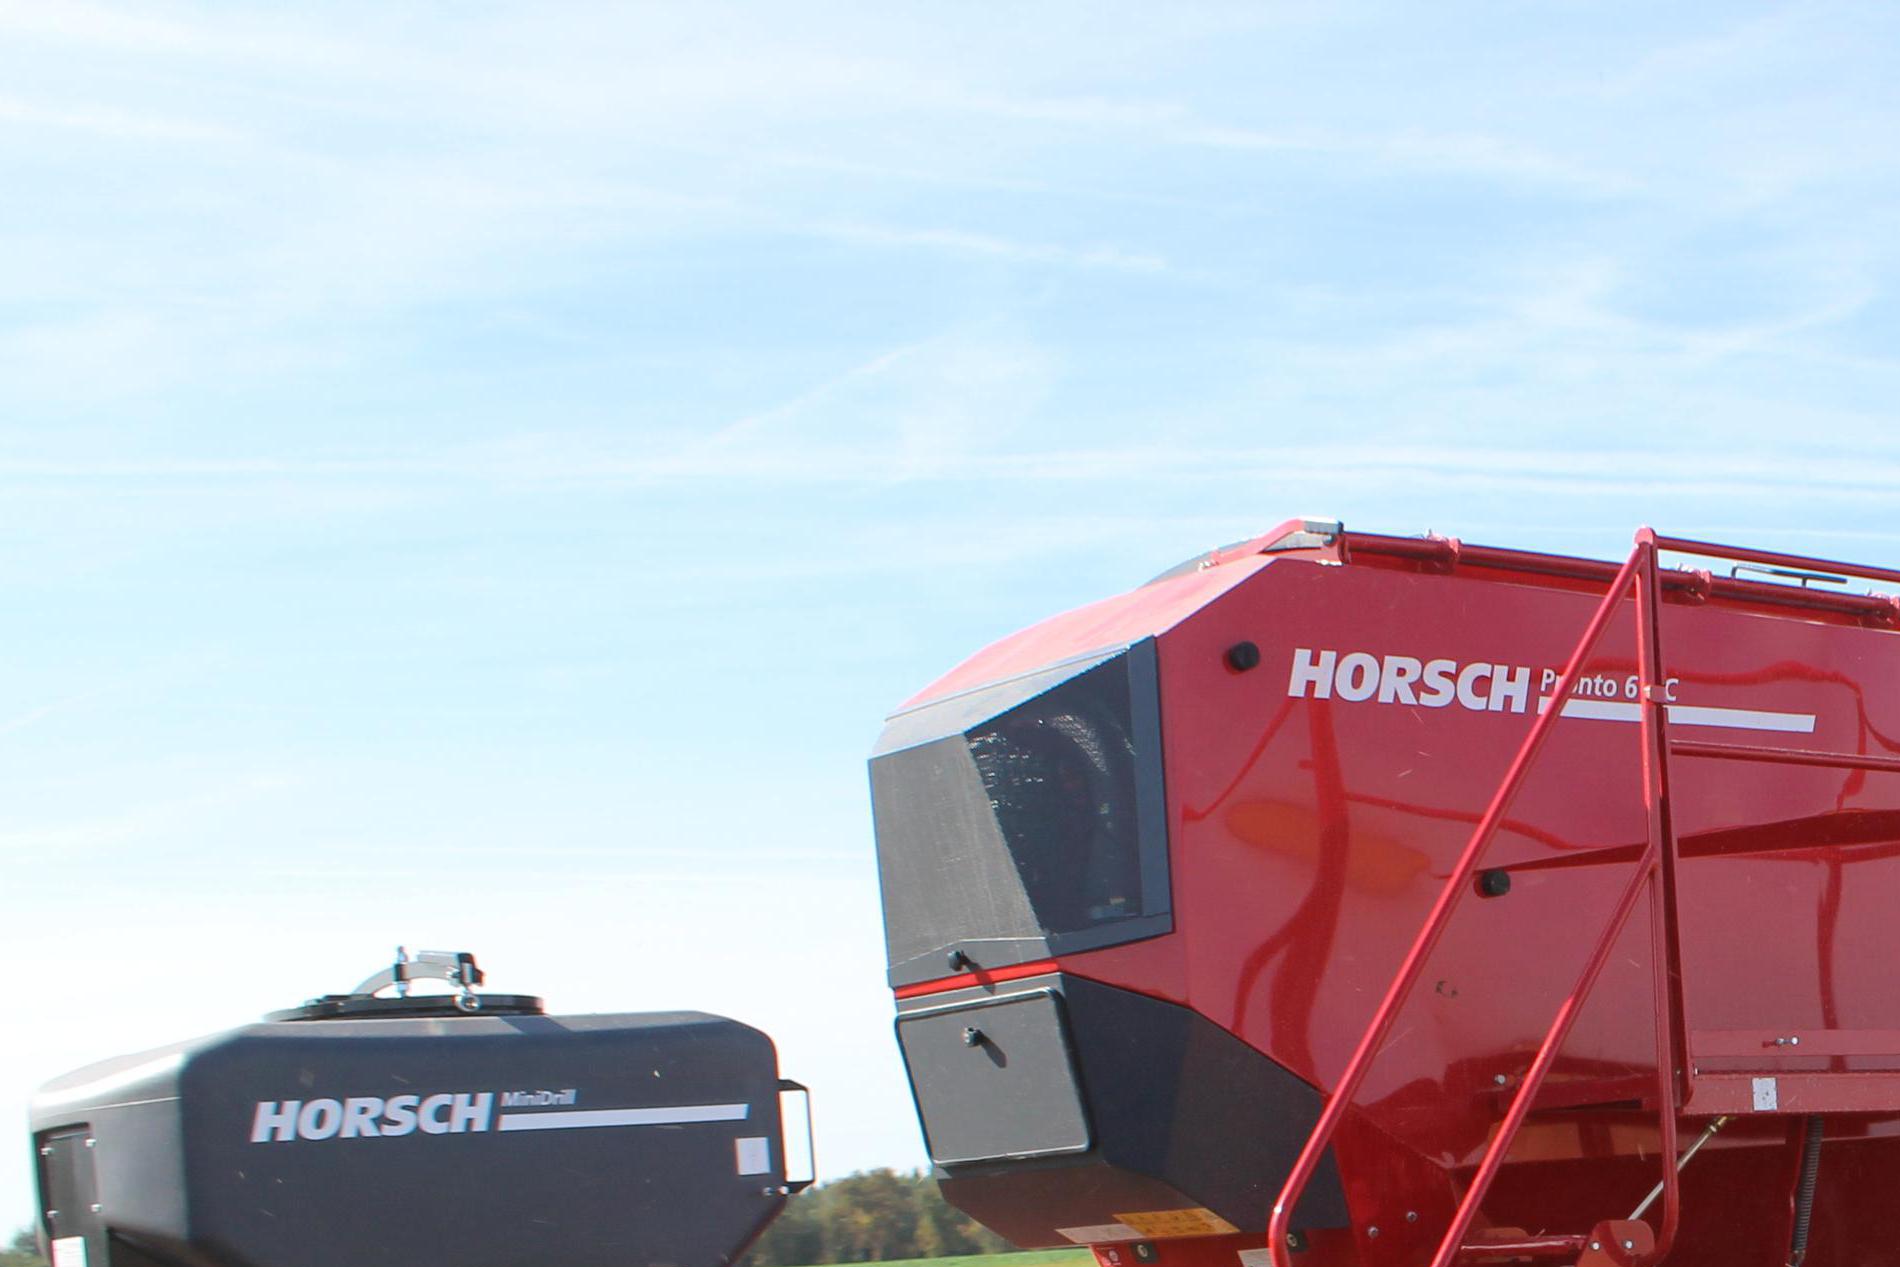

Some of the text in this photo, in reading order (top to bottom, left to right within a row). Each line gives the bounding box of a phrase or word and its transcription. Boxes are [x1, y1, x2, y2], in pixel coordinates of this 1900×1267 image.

[1287, 648, 1531, 713] HORSCH
[1540, 669, 1618, 698] Prnto
[250, 1088, 577, 1143] HORSCH MiniDrill
